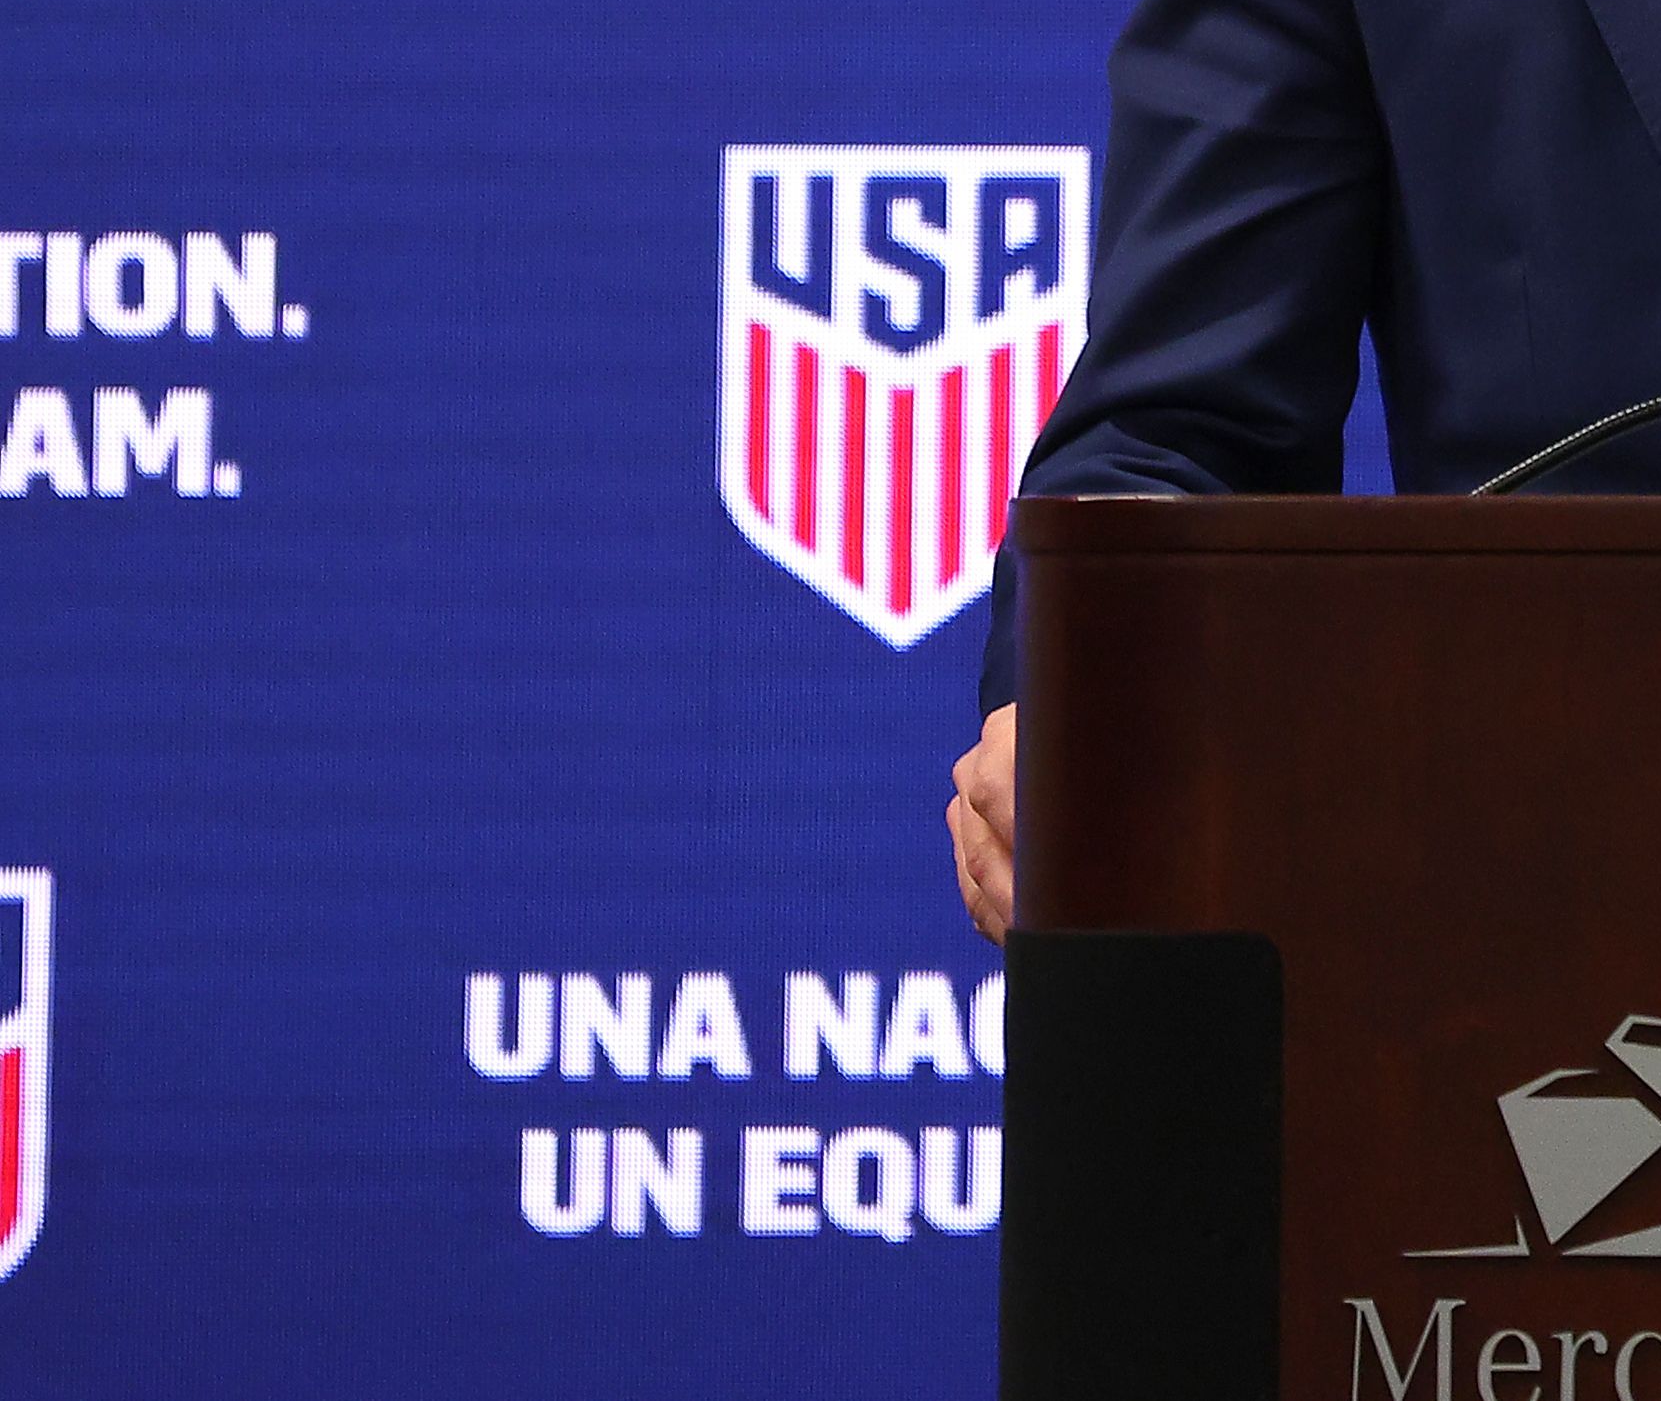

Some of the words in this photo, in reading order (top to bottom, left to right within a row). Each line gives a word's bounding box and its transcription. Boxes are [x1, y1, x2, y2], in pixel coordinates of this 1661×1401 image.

[751, 170, 1062, 354] USA
[462, 970, 753, 1083] UNA
[519, 1125, 704, 1239] UN
